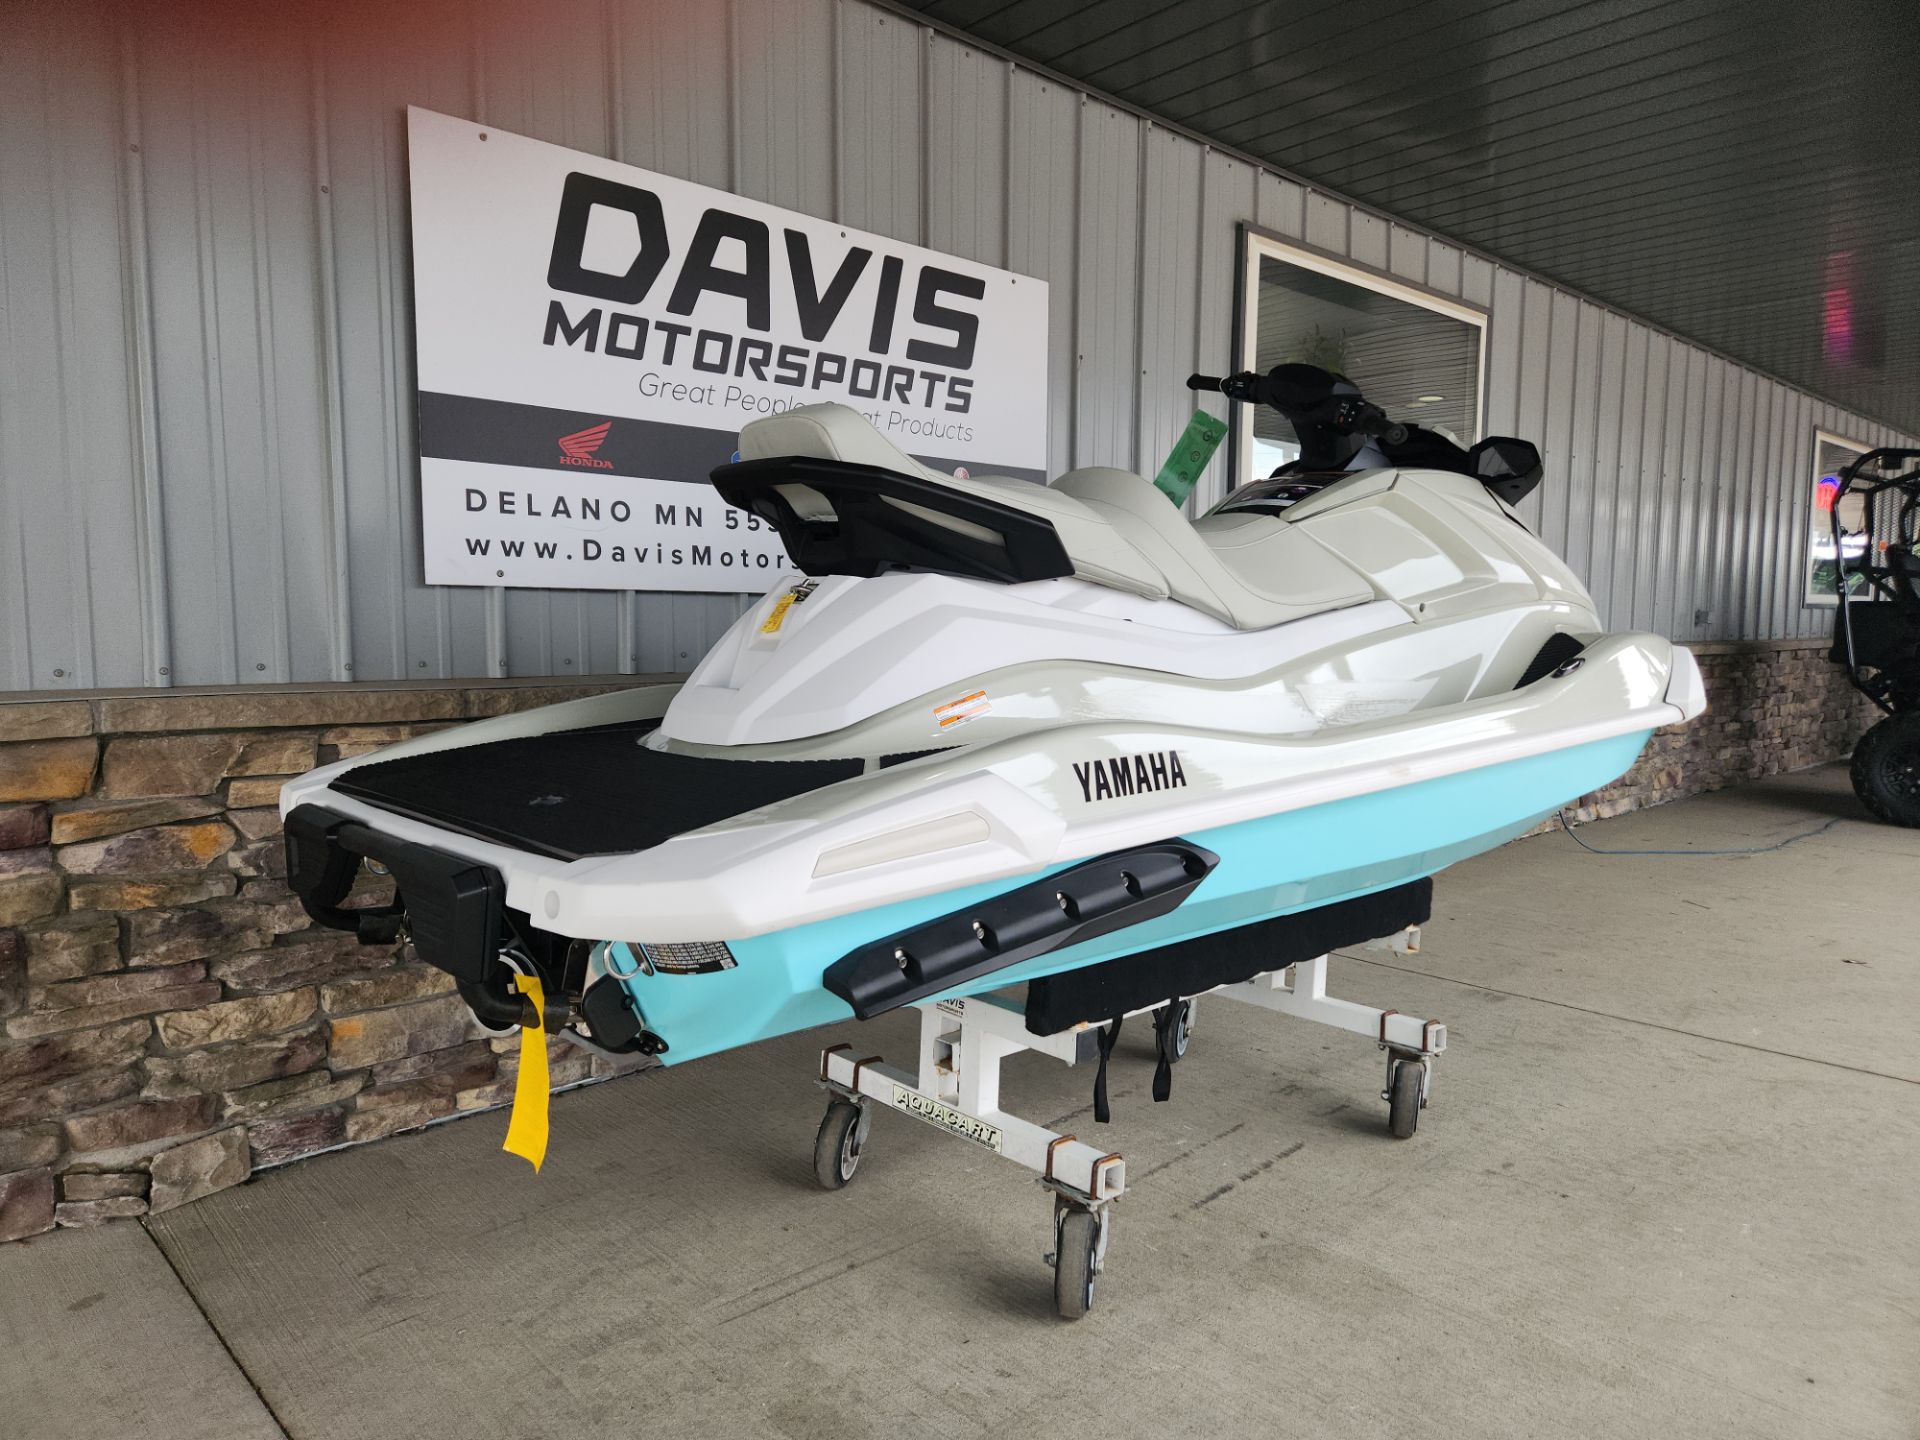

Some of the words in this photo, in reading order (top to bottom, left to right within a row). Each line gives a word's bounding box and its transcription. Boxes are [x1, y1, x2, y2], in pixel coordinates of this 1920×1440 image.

[547, 171, 986, 370] DAVIS
[543, 300, 974, 413] MOTORSPORTS
[638, 372, 716, 407] Great
[887, 410, 973, 442] Products
[559, 456, 614, 470] HONDA
[465, 488, 631, 523] DELANO
[655, 503, 703, 528] MN
[1072, 750, 1188, 802] YAMAHA
[897, 1091, 997, 1142] AQUACART
